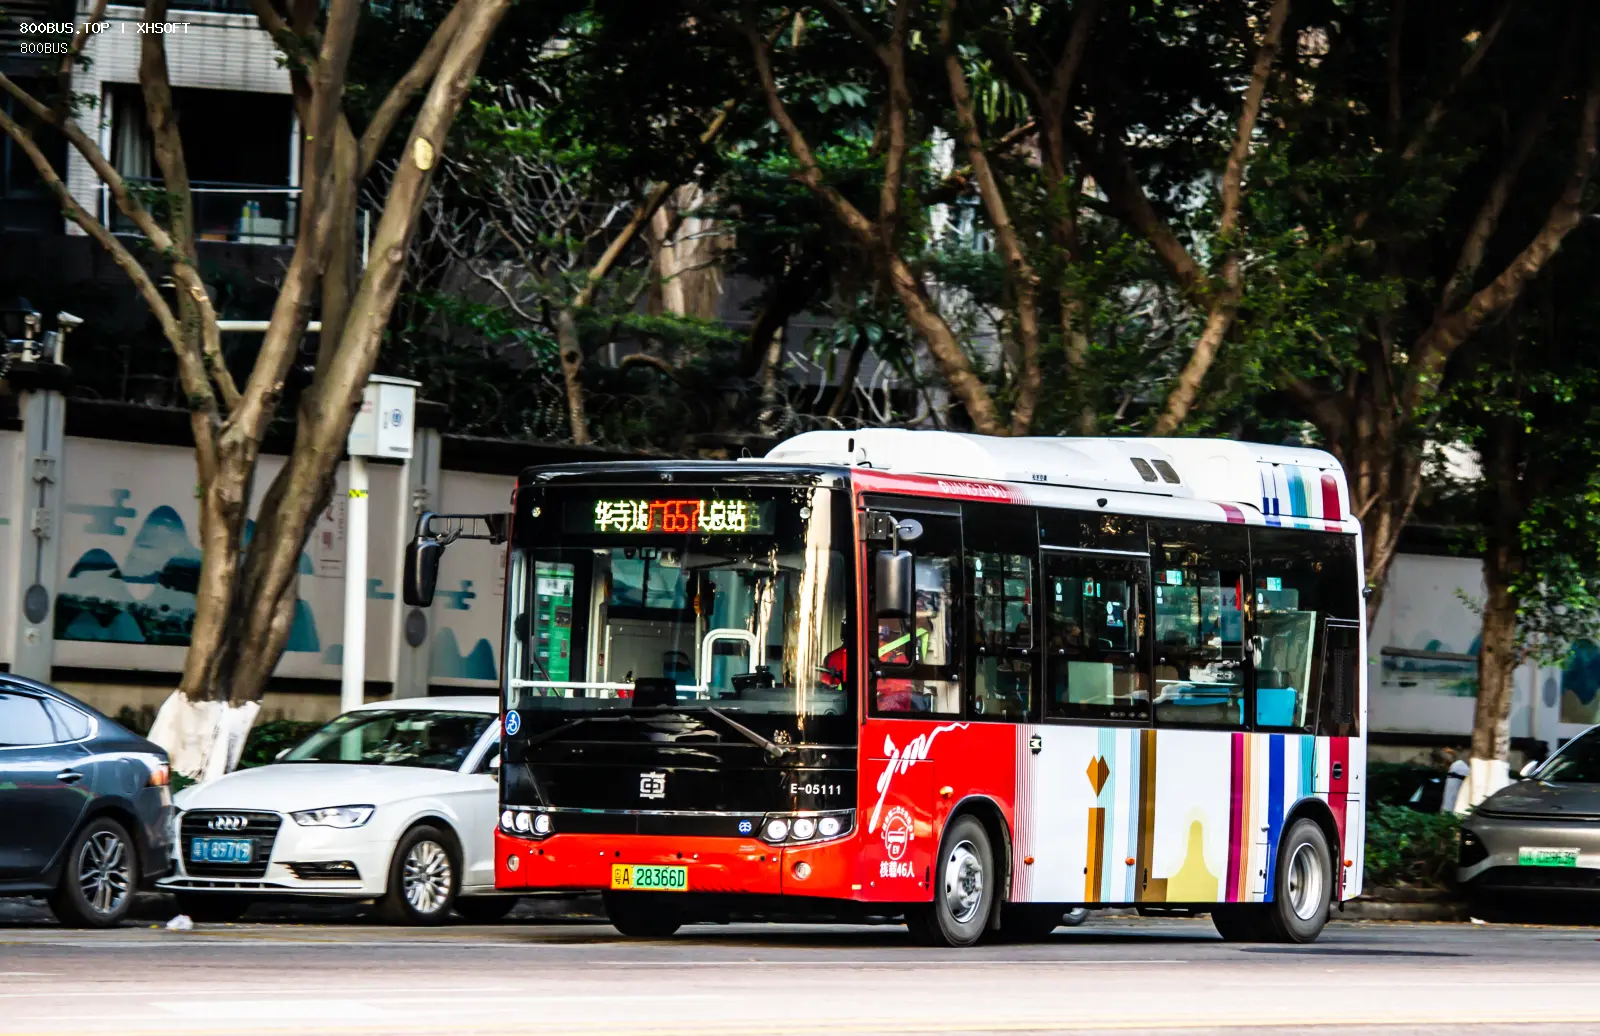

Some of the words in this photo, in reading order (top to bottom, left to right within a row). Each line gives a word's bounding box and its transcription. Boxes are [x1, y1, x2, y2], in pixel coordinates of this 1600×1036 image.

[938, 480, 1006, 498] GUANGZHOU
[790, 783, 841, 795] E-05111
[636, 868, 685, 887] 28366D
